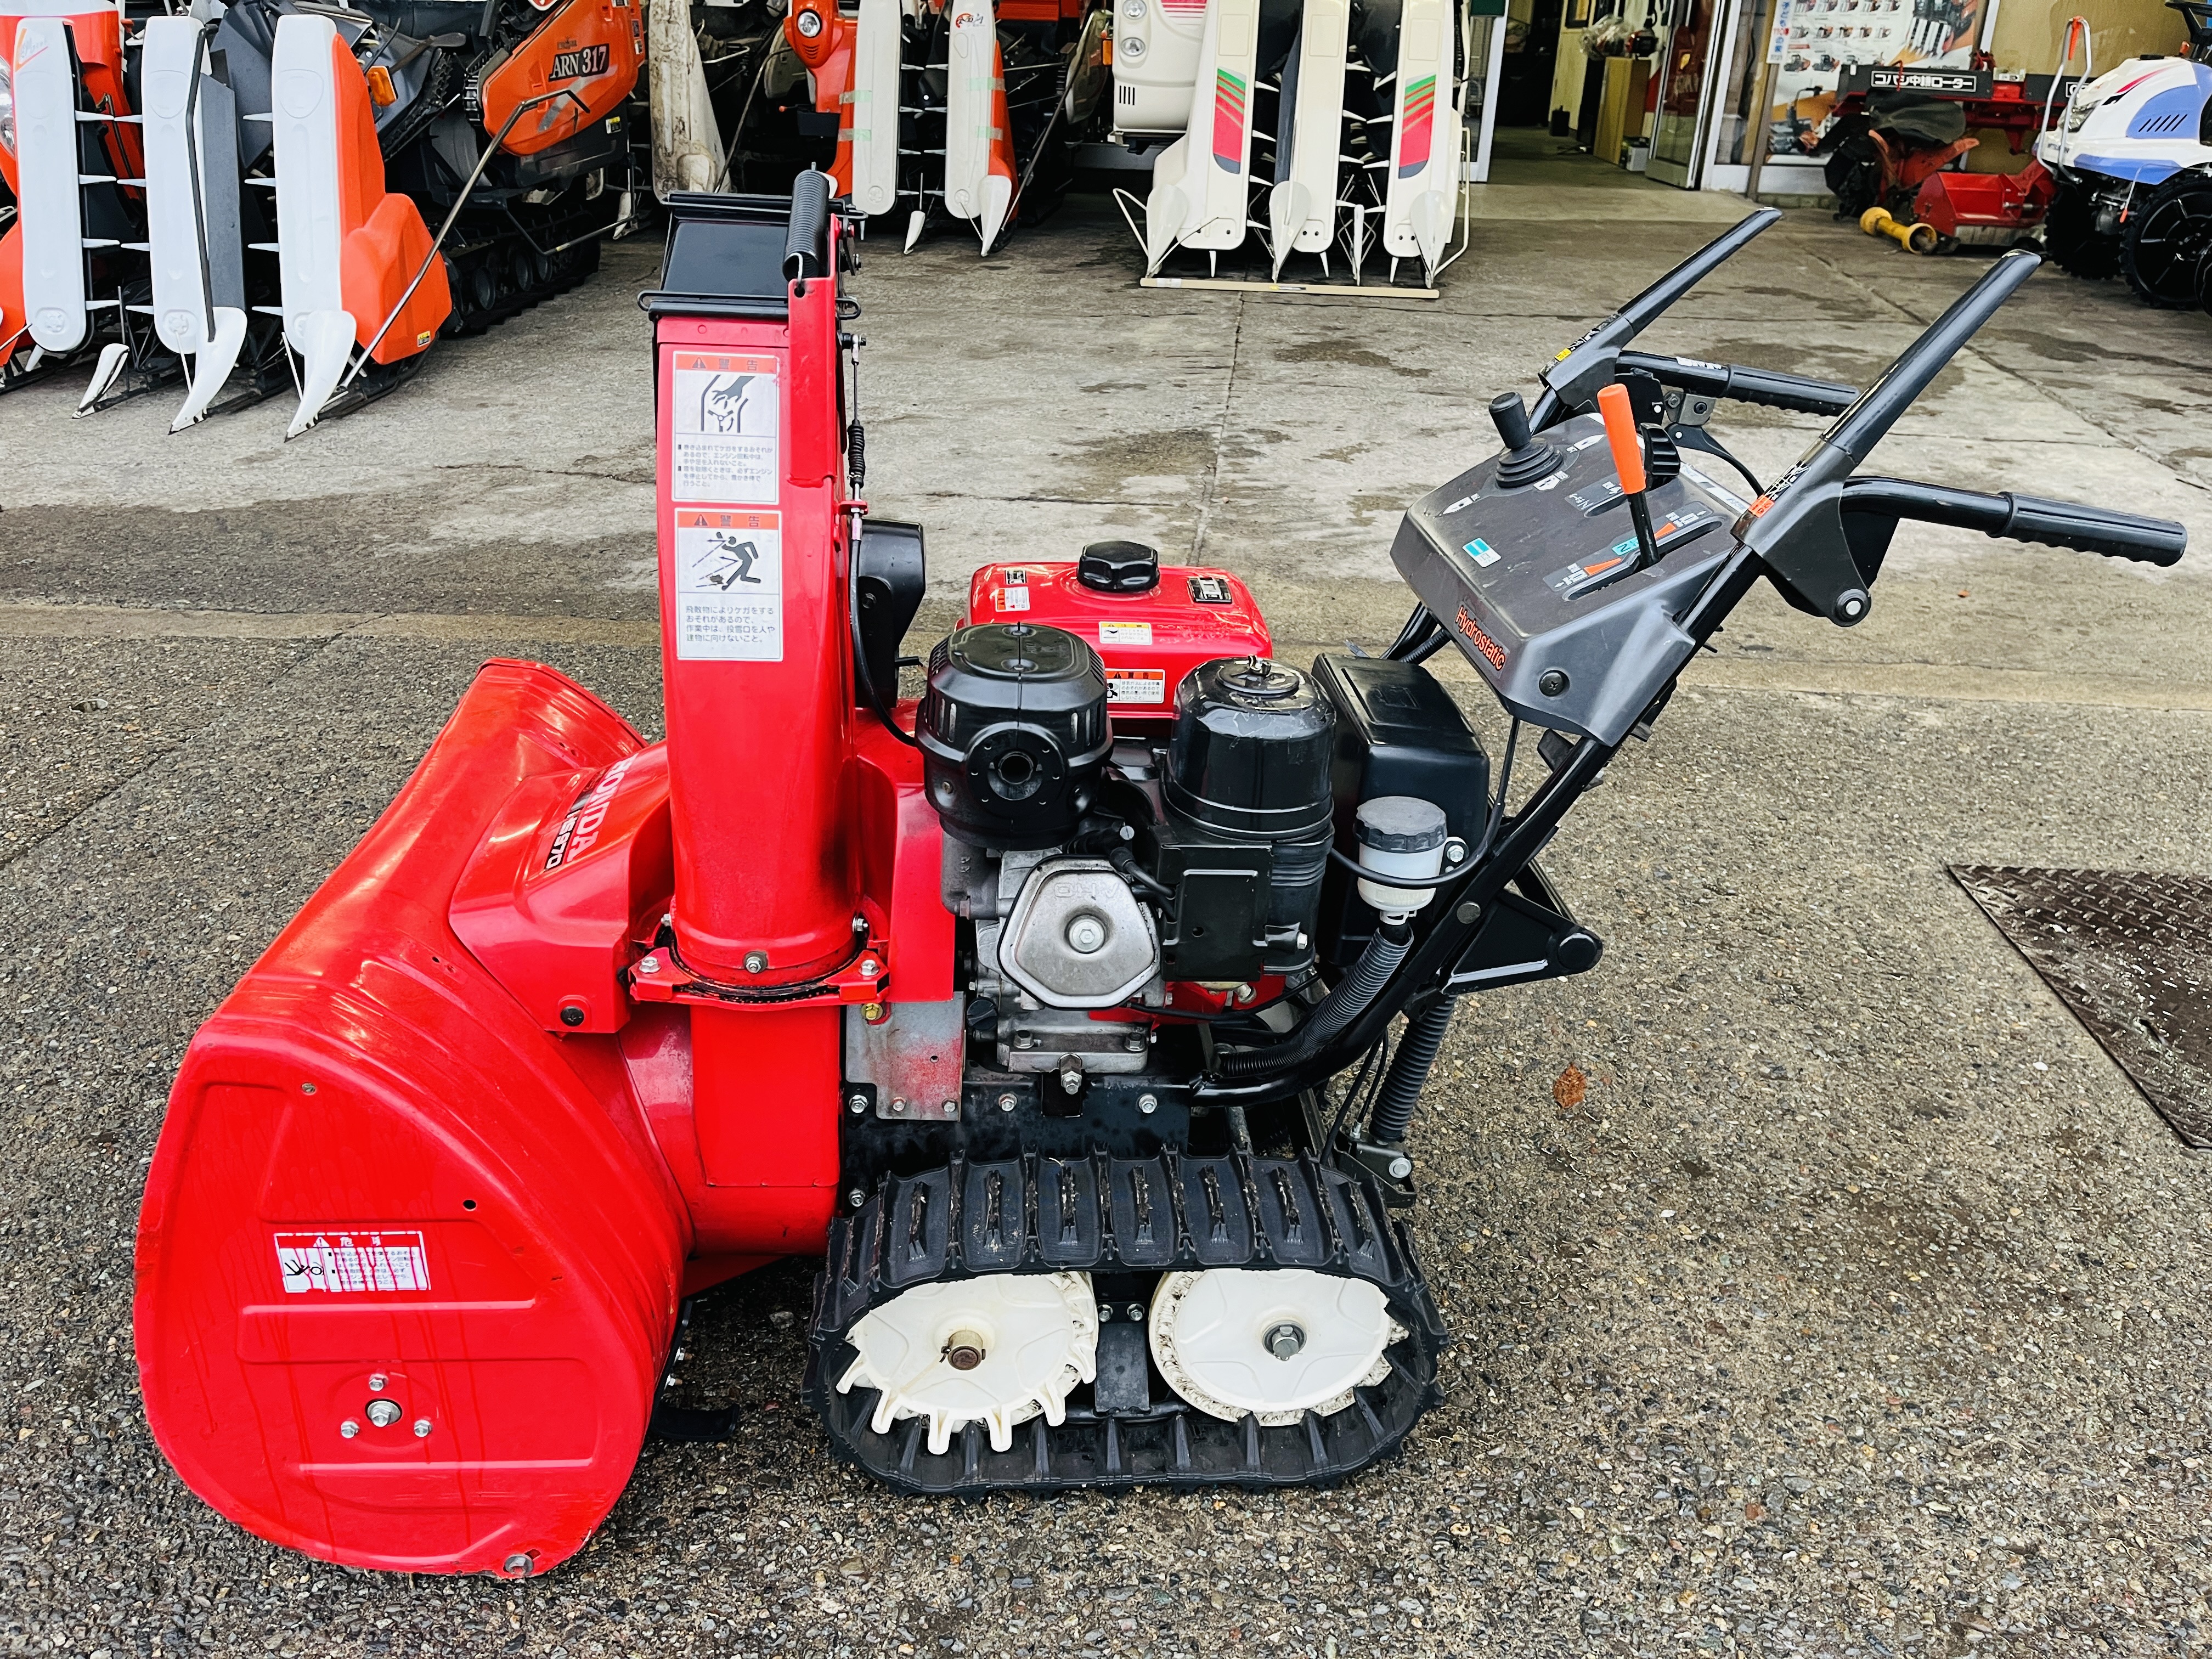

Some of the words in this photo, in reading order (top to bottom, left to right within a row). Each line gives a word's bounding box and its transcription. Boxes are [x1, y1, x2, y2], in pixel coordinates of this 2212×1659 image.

[550, 54, 579, 78] ARN
[582, 46, 606, 73] 317
[686, 606, 774, 614] 飛散物によりケガをする
[686, 616, 754, 624] おそれがあるので、
[686, 634, 763, 643] 建物に向けないこと。
[1455, 605, 1505, 671] Hydrostatic
[567, 753, 639, 862] HONDA
[546, 810, 580, 869] HS970
